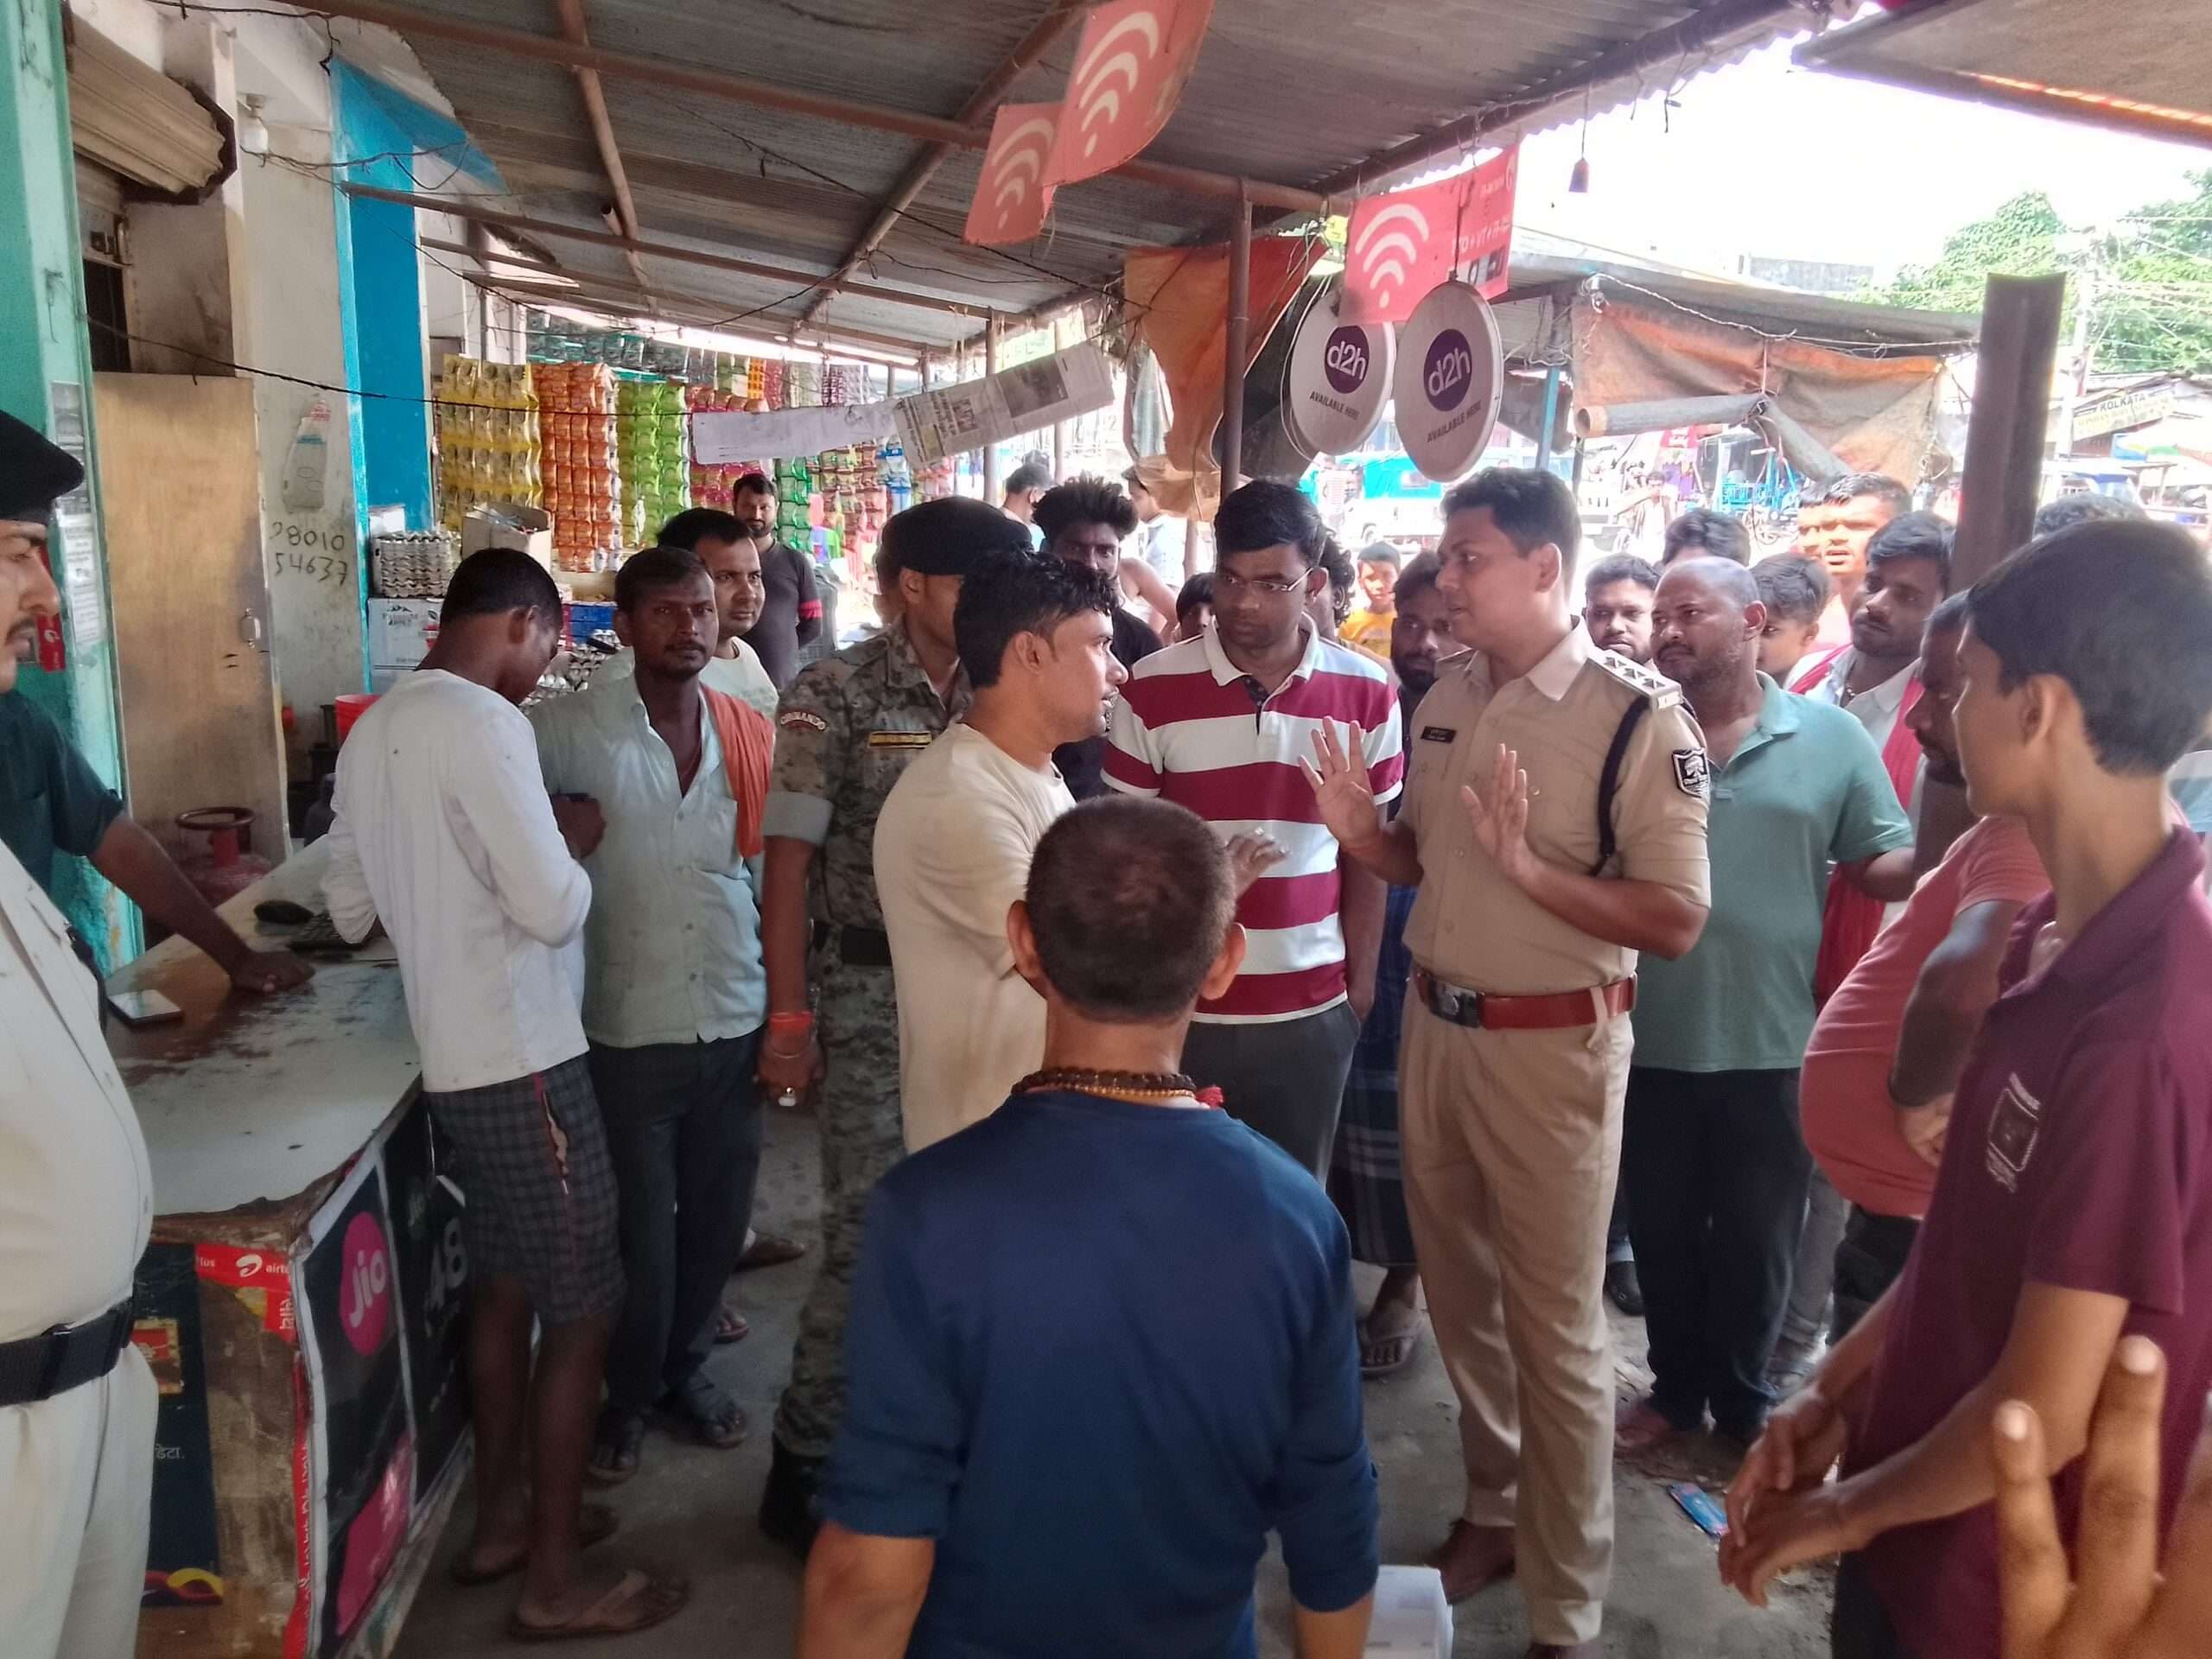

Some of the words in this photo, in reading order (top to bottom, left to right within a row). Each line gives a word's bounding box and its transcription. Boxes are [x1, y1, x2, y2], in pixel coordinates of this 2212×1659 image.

[1326, 340, 1368, 380] d2h
[1427, 347, 1471, 397] d2h
[1309, 391, 1344, 415] AVAILABLE
[1344, 406, 1361, 421] HERE
[1427, 412, 1465, 443] AVAILABLE
[1465, 399, 1482, 423] HERE
[2100, 393, 2146, 412] KOLKATA
[275, 552, 349, 587] 54637
